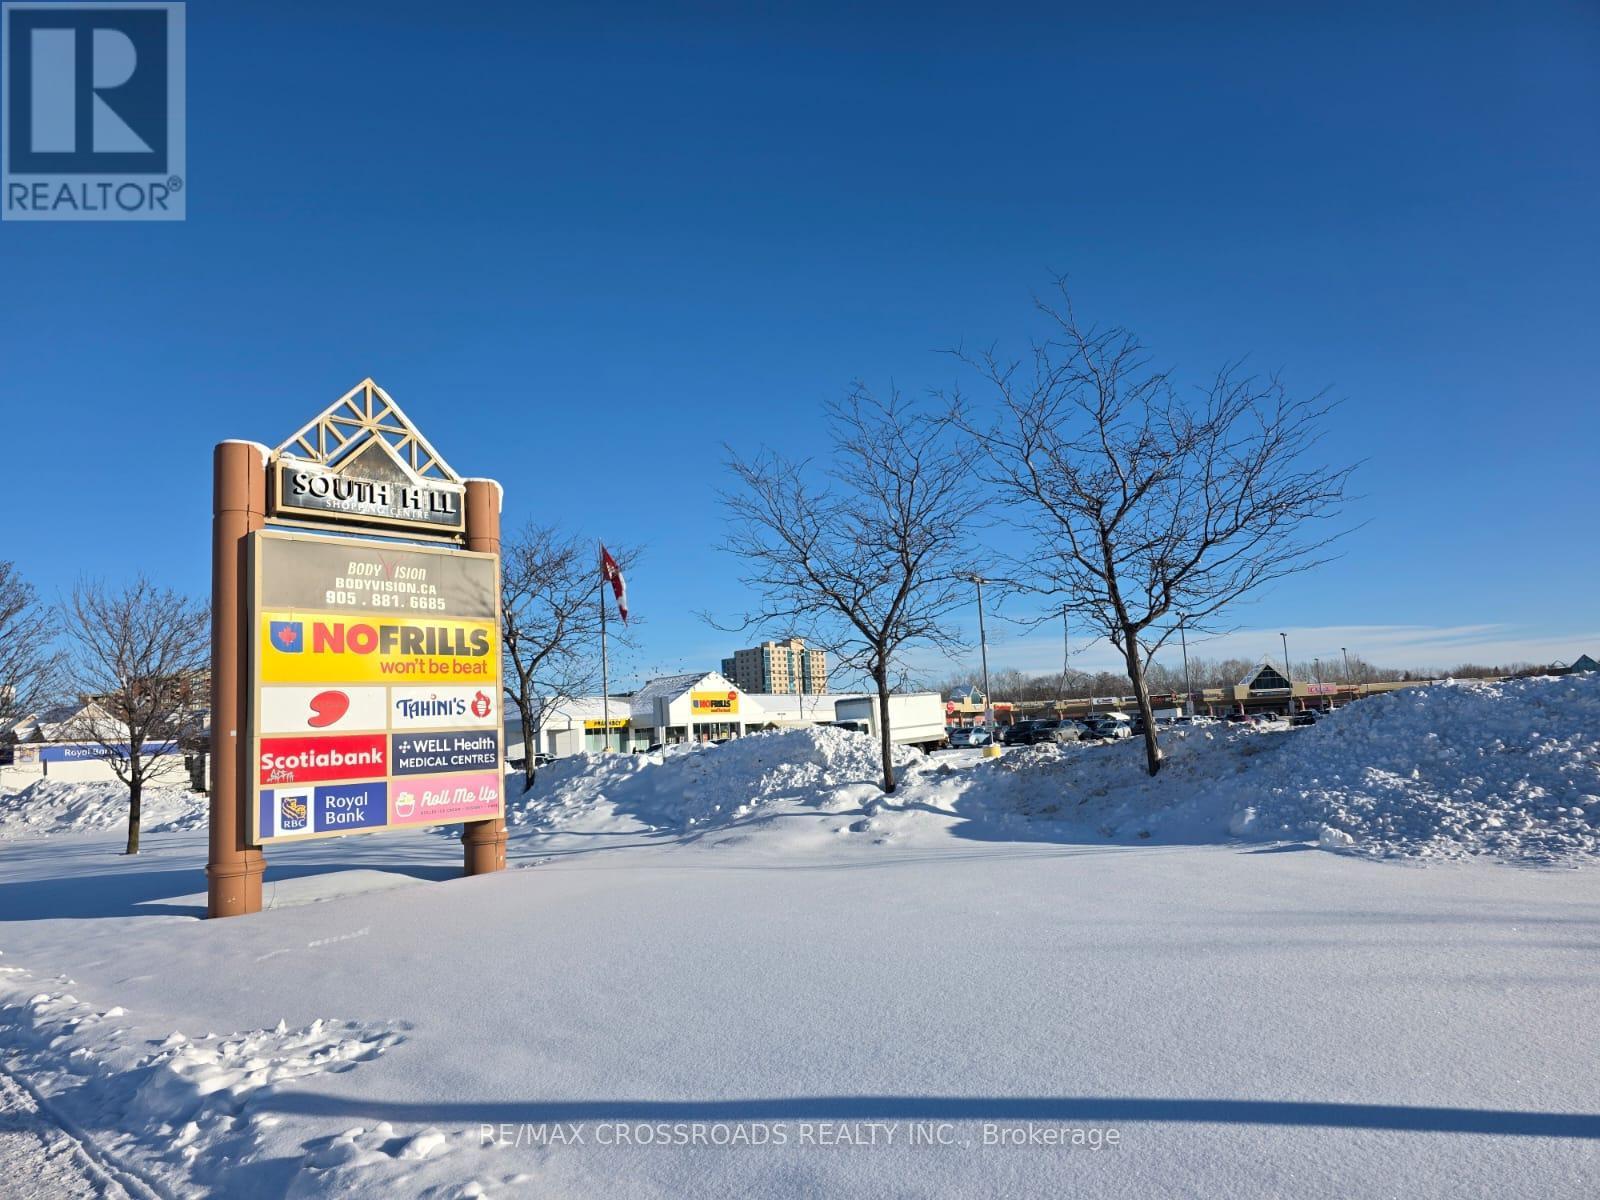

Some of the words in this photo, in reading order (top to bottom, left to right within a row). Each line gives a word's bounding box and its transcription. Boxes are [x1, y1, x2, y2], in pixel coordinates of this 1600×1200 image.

[292, 473, 391, 506] SOUTH
[326, 499, 385, 515] SHOPPING
[391, 507, 430, 520] CENTRE
[348, 561, 381, 576] BODY
[335, 577, 437, 595] BODYVISION.CA
[326, 590, 356, 605] 905
[410, 596, 446, 610] 6685
[380, 659, 426, 674] won't
[429, 658, 450, 674] be
[453, 660, 487, 675] beat
[64, 748, 90, 758] Royal
[413, 739, 451, 753] WELL
[454, 737, 495, 752] Health
[261, 747, 383, 770] Scotiabank
[399, 756, 448, 769] MEDICAL
[450, 753, 496, 765] CENTRES
[325, 791, 368, 811] Royal
[420, 790, 450, 807] Roll
[453, 788, 476, 803] Me
[478, 785, 498, 803] Up
[283, 819, 305, 829] RBC
[325, 808, 365, 825] Bank
